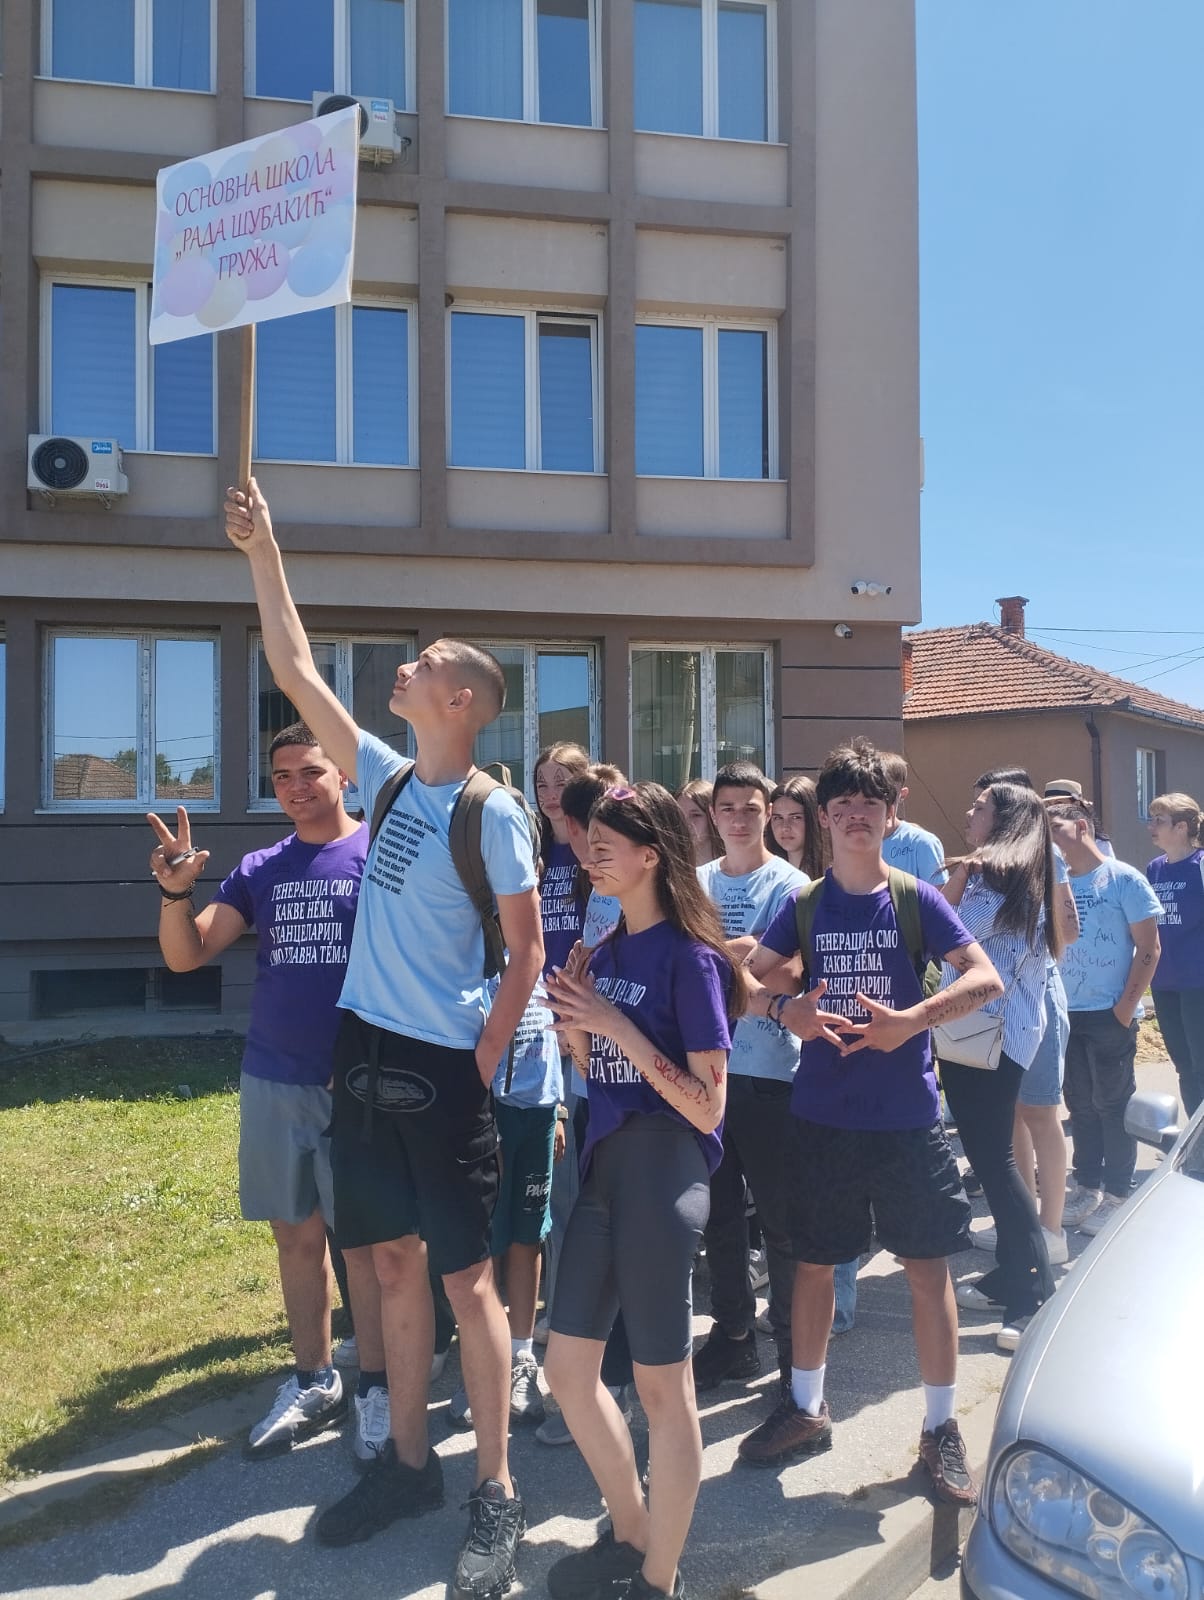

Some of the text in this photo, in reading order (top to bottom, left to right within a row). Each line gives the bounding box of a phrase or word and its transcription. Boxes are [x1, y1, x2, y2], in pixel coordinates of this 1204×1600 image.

[175, 147, 336, 217] ОСНОВНА ШКОЛА
[175, 188, 333, 261] „РАДА ШУБАКИЋ“
[218, 243, 279, 280] ГРУЖА
[271, 879, 354, 901] ГЕНЕРАЦИЈА СМО
[274, 900, 334, 922] КАКВЕ НЕМА
[815, 929, 898, 954] ГЕНЕРАЦИЈА СМО
[319, 945, 348, 964] ТЕМА
[823, 953, 884, 974] КАКВЕ НЕМА
[606, 1060, 642, 1083] ТЕМА
